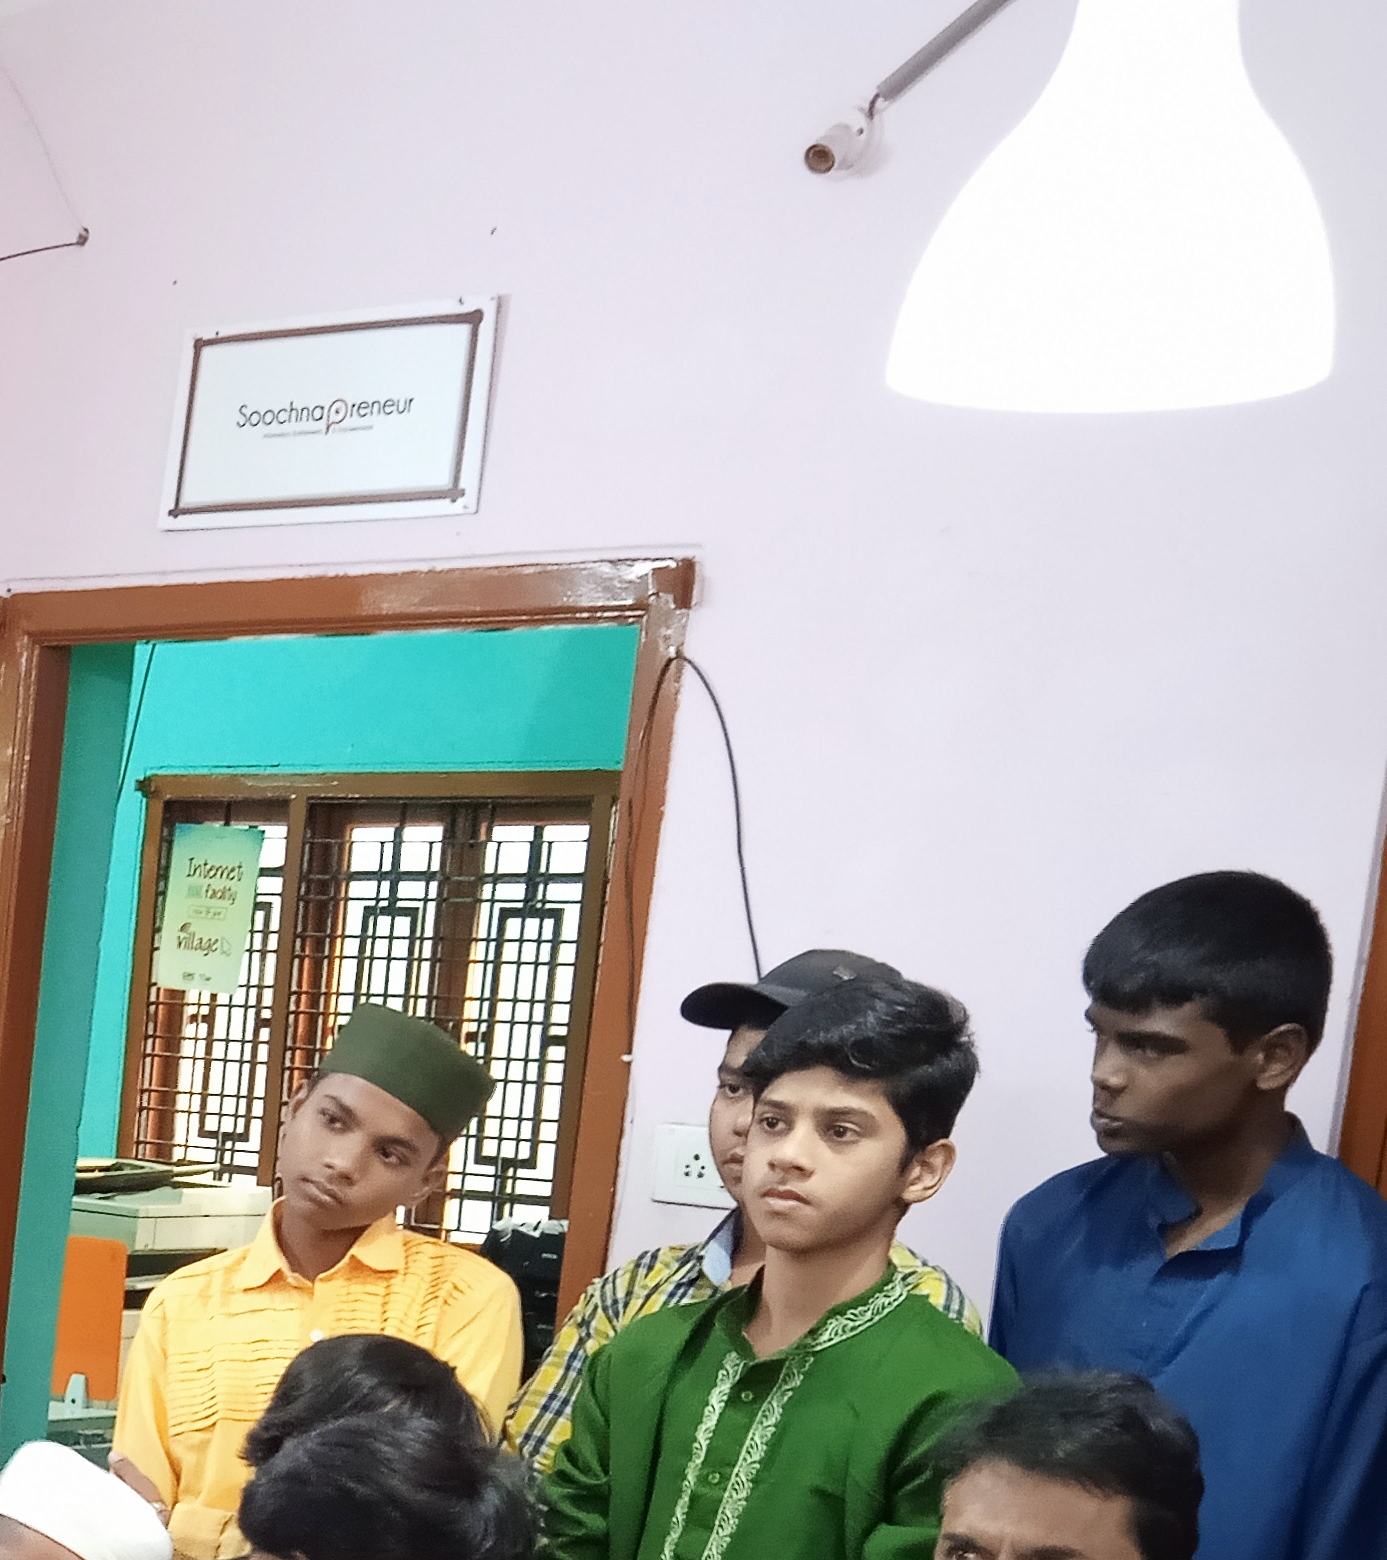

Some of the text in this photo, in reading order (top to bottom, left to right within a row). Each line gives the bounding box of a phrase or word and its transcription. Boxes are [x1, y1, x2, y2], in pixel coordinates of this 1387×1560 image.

[186, 856, 244, 883] Internet
[204, 883, 238, 905] facility
[176, 932, 220, 956] village
